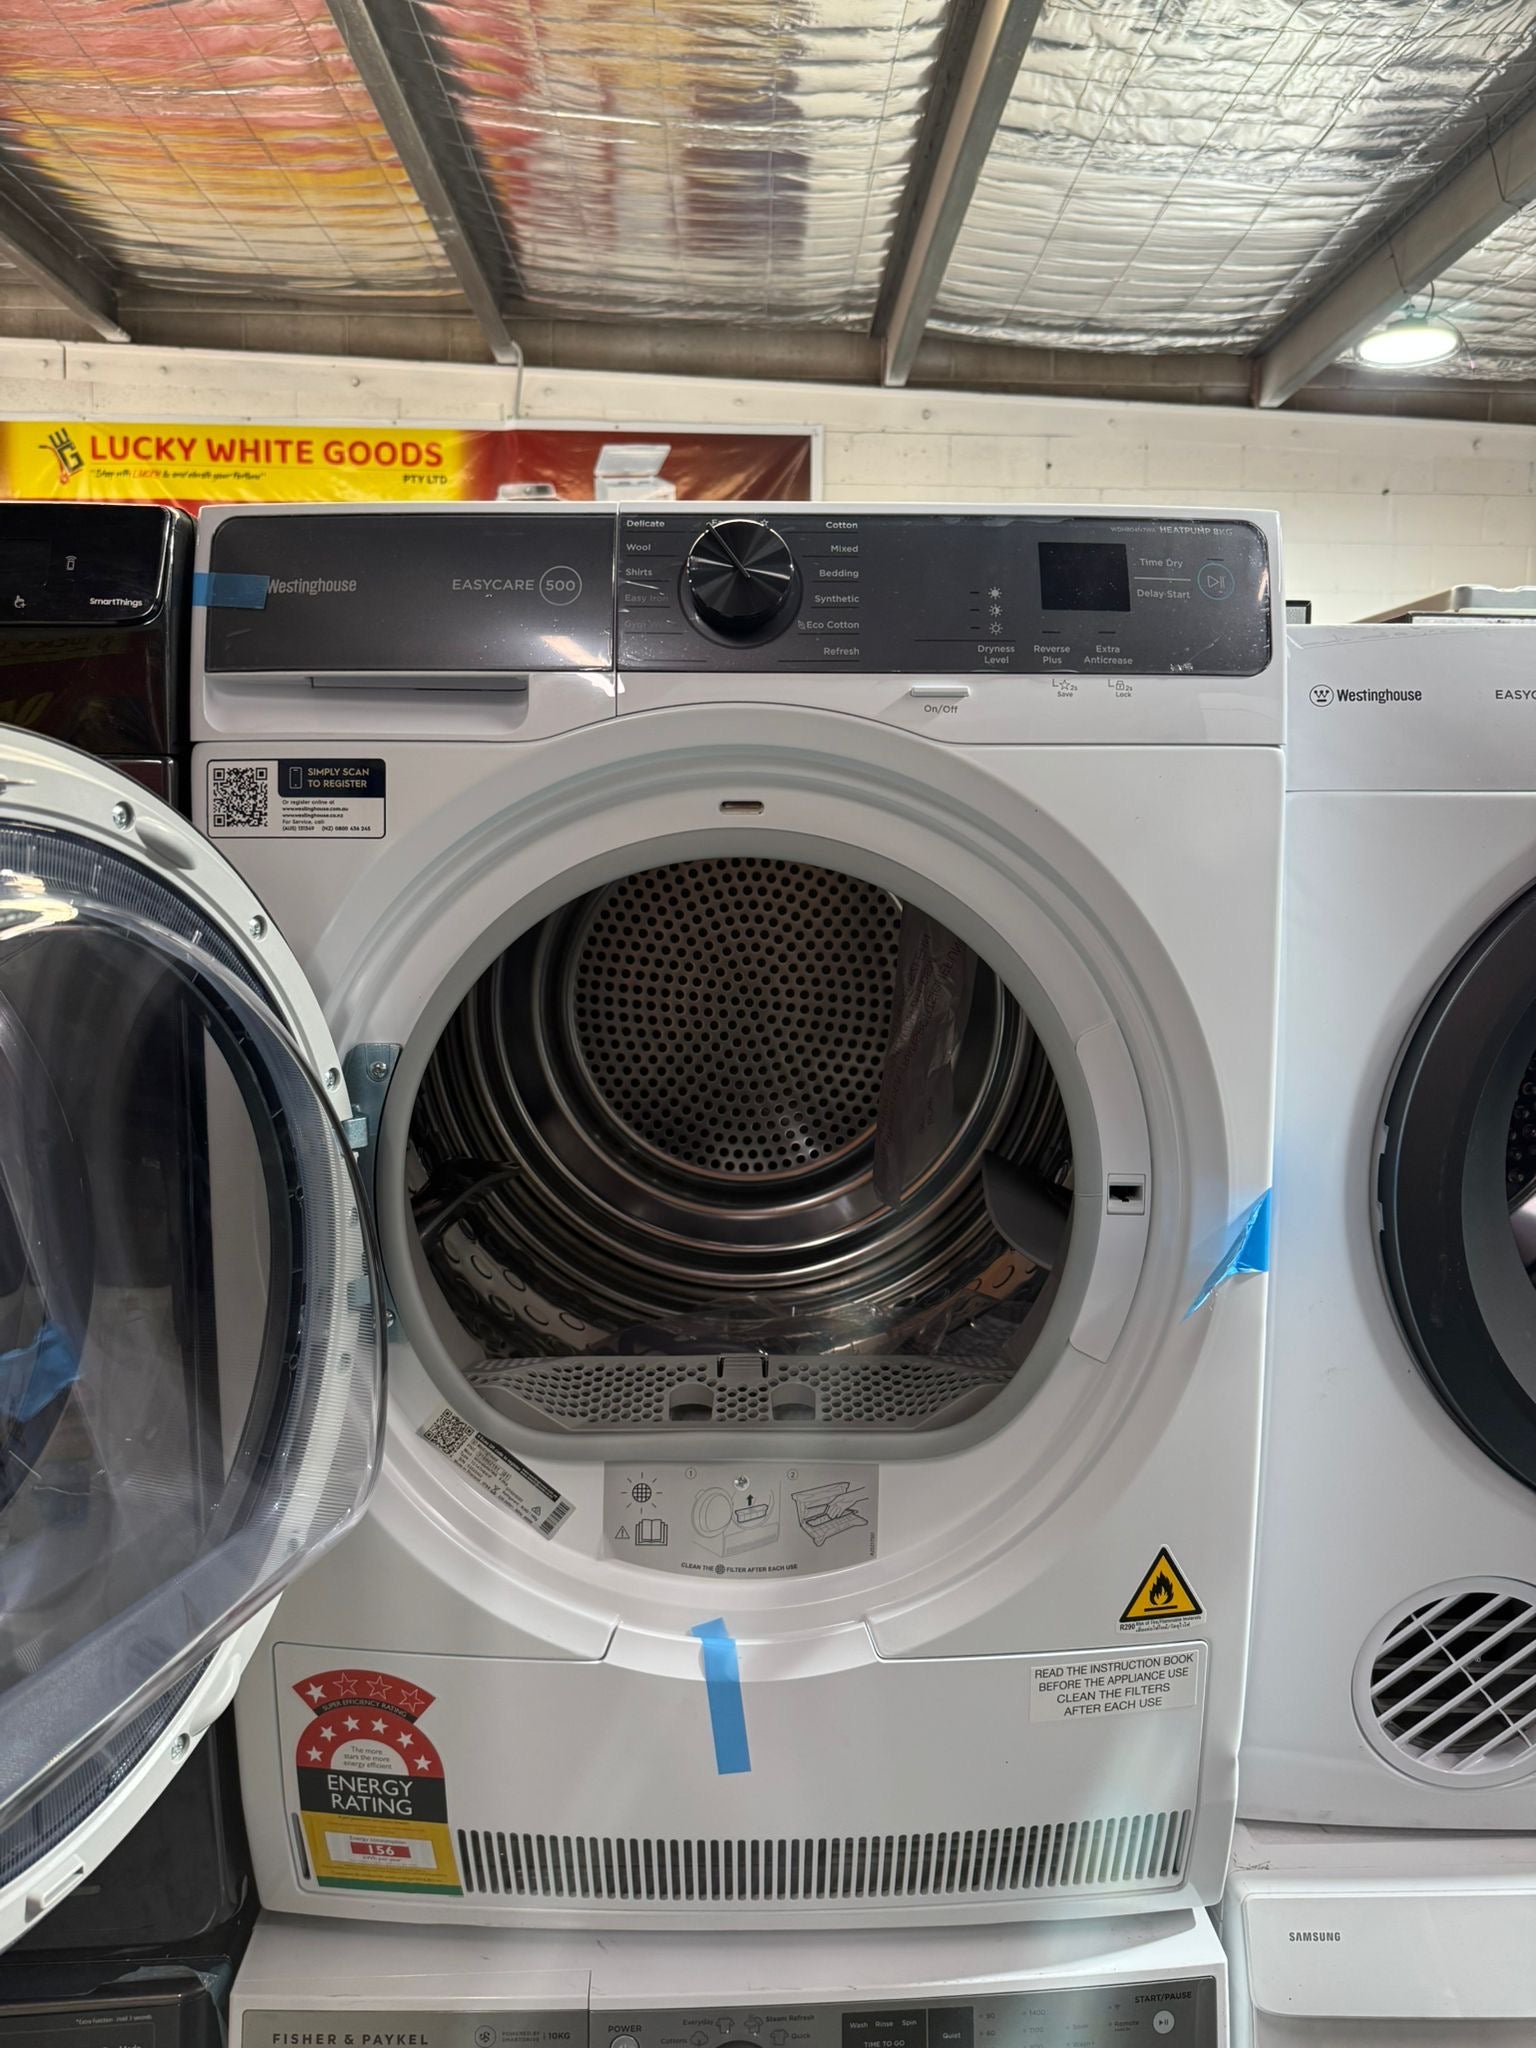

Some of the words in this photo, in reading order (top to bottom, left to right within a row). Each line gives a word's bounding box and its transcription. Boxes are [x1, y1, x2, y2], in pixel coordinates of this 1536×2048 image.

[91, 435, 197, 461] LUCKY
[206, 438, 313, 464] WHITE
[323, 440, 443, 467] GOODS
[403, 474, 424, 485] PTY
[426, 474, 448, 485] LTD
[626, 519, 665, 528] Delicate
[825, 520, 859, 530] Cotton
[1159, 525, 1211, 536] HEATPUMP
[1212, 527, 1233, 537] 8KG
[626, 543, 651, 552] Wool
[830, 544, 859, 553] Mixed
[1139, 558, 1163, 567] Time
[1165, 558, 1183, 569] Dry
[625, 568, 653, 577] Shirts
[818, 569, 860, 580] Bedding
[268, 578, 357, 596] Westinghouse
[452, 578, 535, 591] EASYCARE
[545, 579, 576, 592] 500
[624, 593, 647, 604] Easy
[1136, 589, 1164, 599] Delay
[1165, 589, 1191, 599] Start
[89, 597, 143, 608] SmartThings
[814, 594, 860, 605] Synthetic
[806, 620, 825, 630] Eco
[826, 620, 860, 630] Cotton
[823, 646, 860, 656] Refresh
[977, 644, 1016, 655] Dryness
[1033, 644, 1071, 654] Reverse
[1095, 644, 1121, 654] Extra
[984, 656, 1010, 665] Level
[1042, 656, 1063, 665] Plus
[1083, 656, 1134, 666] Anticrease
[1115, 690, 1132, 698] Lock
[1336, 688, 1422, 704] Westinghouse
[923, 703, 959, 714] On/Off
[307, 767, 341, 777] SIMPLY
[342, 767, 370, 777] SCAN
[307, 779, 321, 788] TO
[322, 779, 368, 789] REGISTER
[681, 1562, 701, 1570] CLEAN
[1119, 1623, 1135, 1631] R290
[1035, 1668, 1064, 1679] READ
[1067, 1666, 1087, 1677] THE
[1090, 1658, 1161, 1675] INSTRUCTION
[1163, 1653, 1194, 1666] BOOK
[1039, 1679, 1081, 1692] BEFORE
[1084, 1677, 1105, 1688] THE
[1107, 1671, 1165, 1686] APPLIANCE
[1168, 1667, 1189, 1679] USE
[1056, 1691, 1096, 1704] CLEAN
[1099, 1688, 1122, 1700] THE
[1125, 1683, 1170, 1697] FILTERS
[322, 1701, 342, 1711] SUPER
[342, 1699, 380, 1708] EFFICIENCY
[380, 1702, 407, 1717] RATING
[1063, 1704, 1101, 1716] AFTER
[1104, 1700, 1136, 1713] EACH
[1139, 1697, 1163, 1709] USE
[351, 1746, 364, 1754] The
[343, 1753, 359, 1761] stars
[343, 1760, 365, 1769] energy
[366, 1761, 392, 1770] efficient
[327, 1774, 413, 1797] ENERGY
[331, 1795, 413, 1816] RATING
[367, 1845, 395, 1856] 156
[1289, 1931, 1341, 1942] SAMSUNG
[1134, 1991, 1192, 2004] START/PAUSE
[902, 2019, 917, 2027] Spin
[608, 2025, 642, 2033] POWER
[273, 2034, 337, 2046] FISHER
[344, 2034, 354, 2045] &
[363, 2034, 428, 2046] PAYKEL
[548, 2032, 571, 2040] 10KG
[893, 2039, 905, 2047] GO
